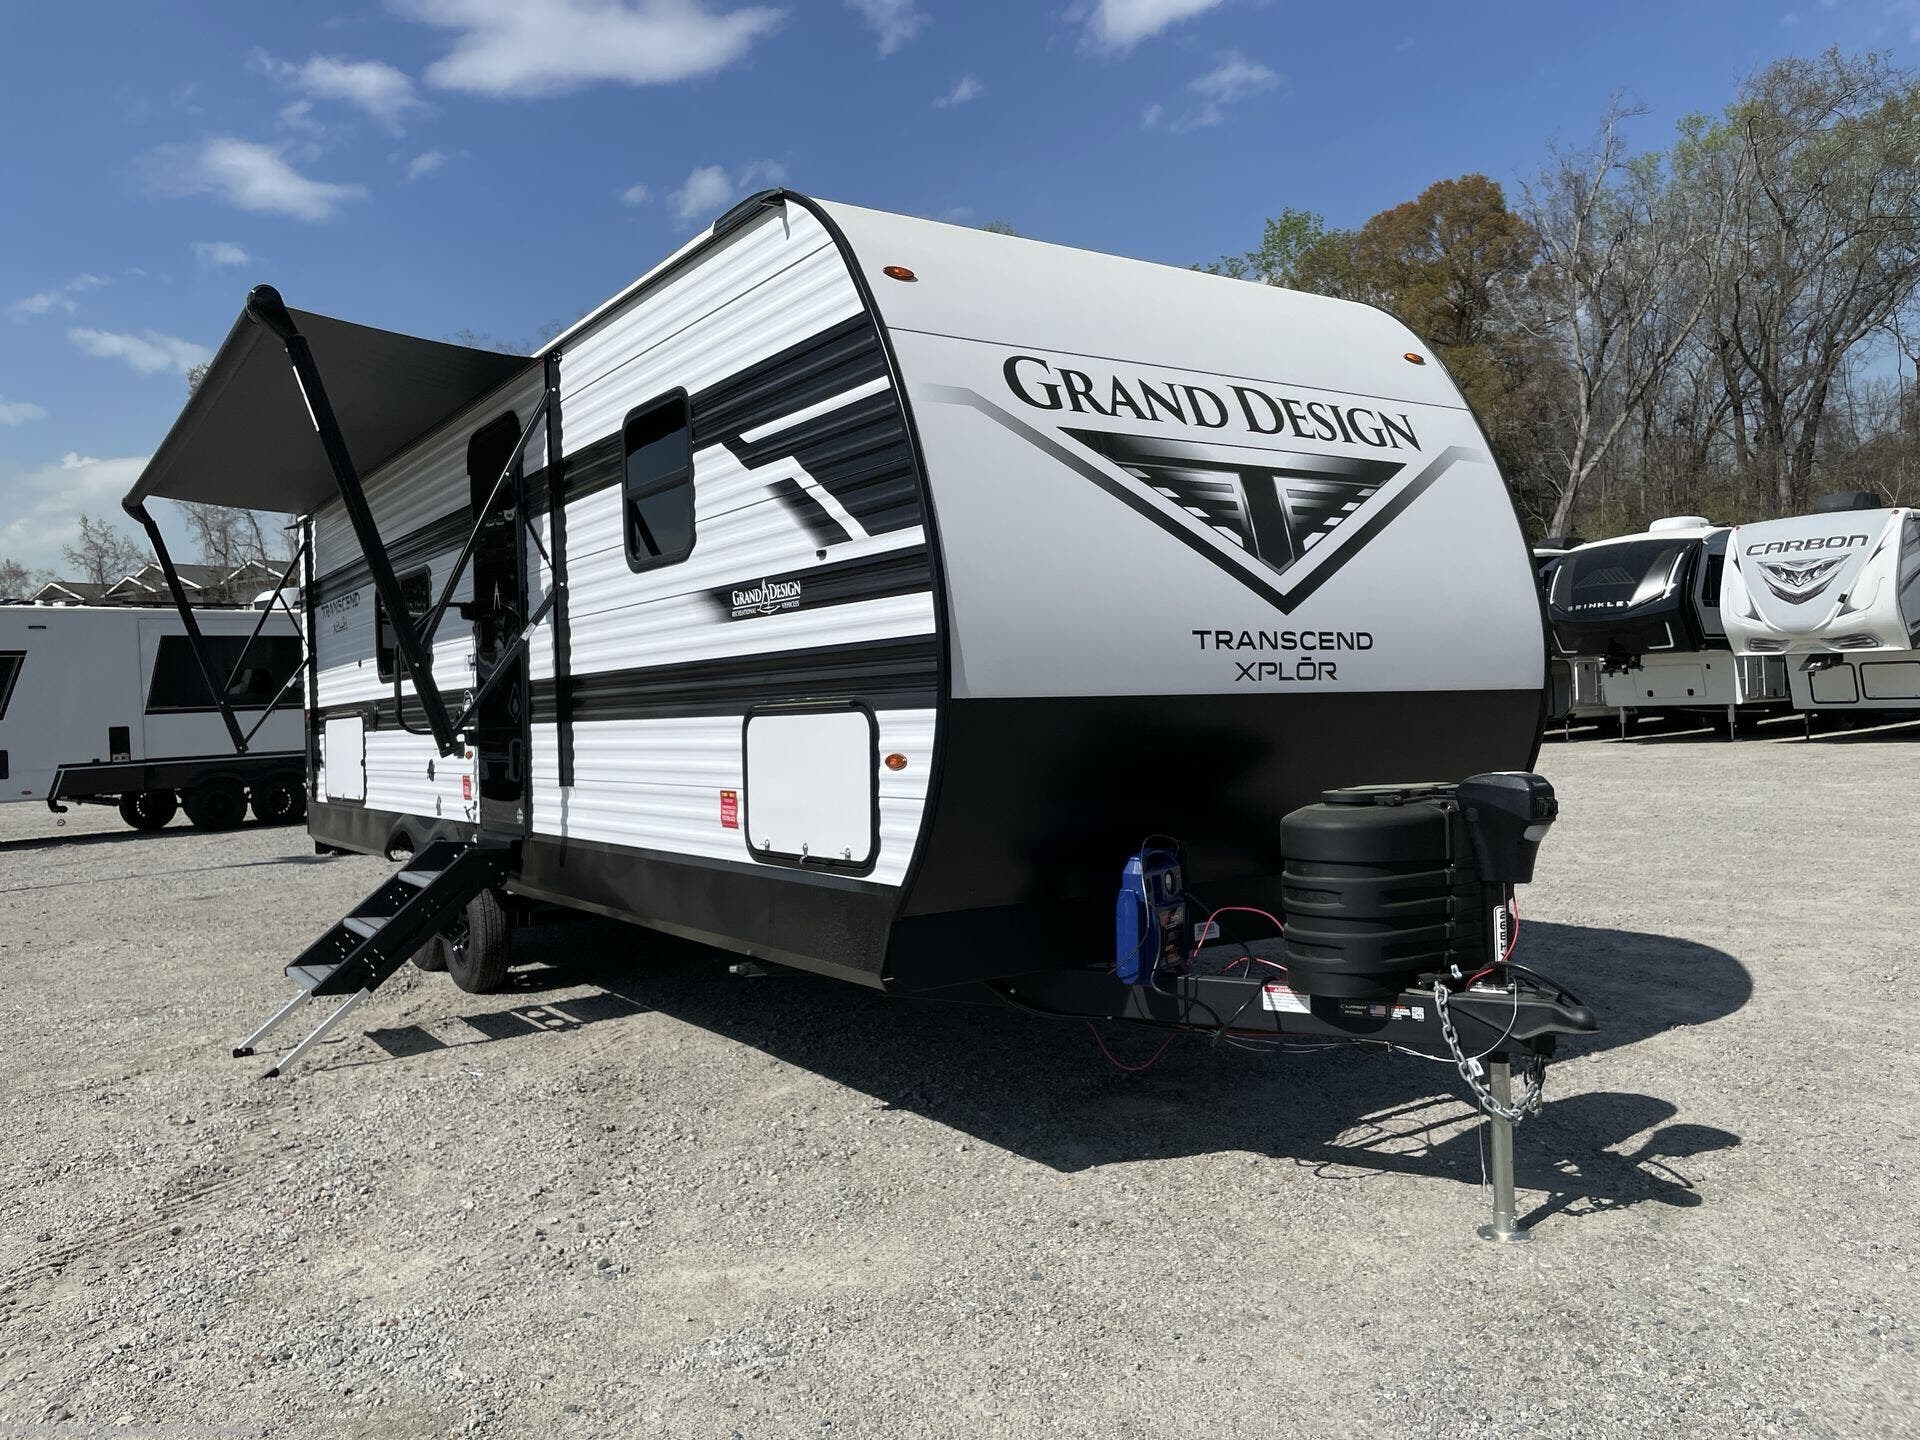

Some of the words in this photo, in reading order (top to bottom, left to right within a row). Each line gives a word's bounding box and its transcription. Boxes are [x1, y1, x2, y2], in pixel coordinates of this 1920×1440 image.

[1003, 354, 1229, 429] GRAND
[1227, 384, 1422, 453] DESIGN
[1745, 533, 1869, 557] CARBON
[732, 589, 762, 606] GRAND
[768, 581, 801, 599] DESIGN
[1567, 600, 1632, 612] BRINKLEY
[1192, 631, 1374, 651] TRANSCEND
